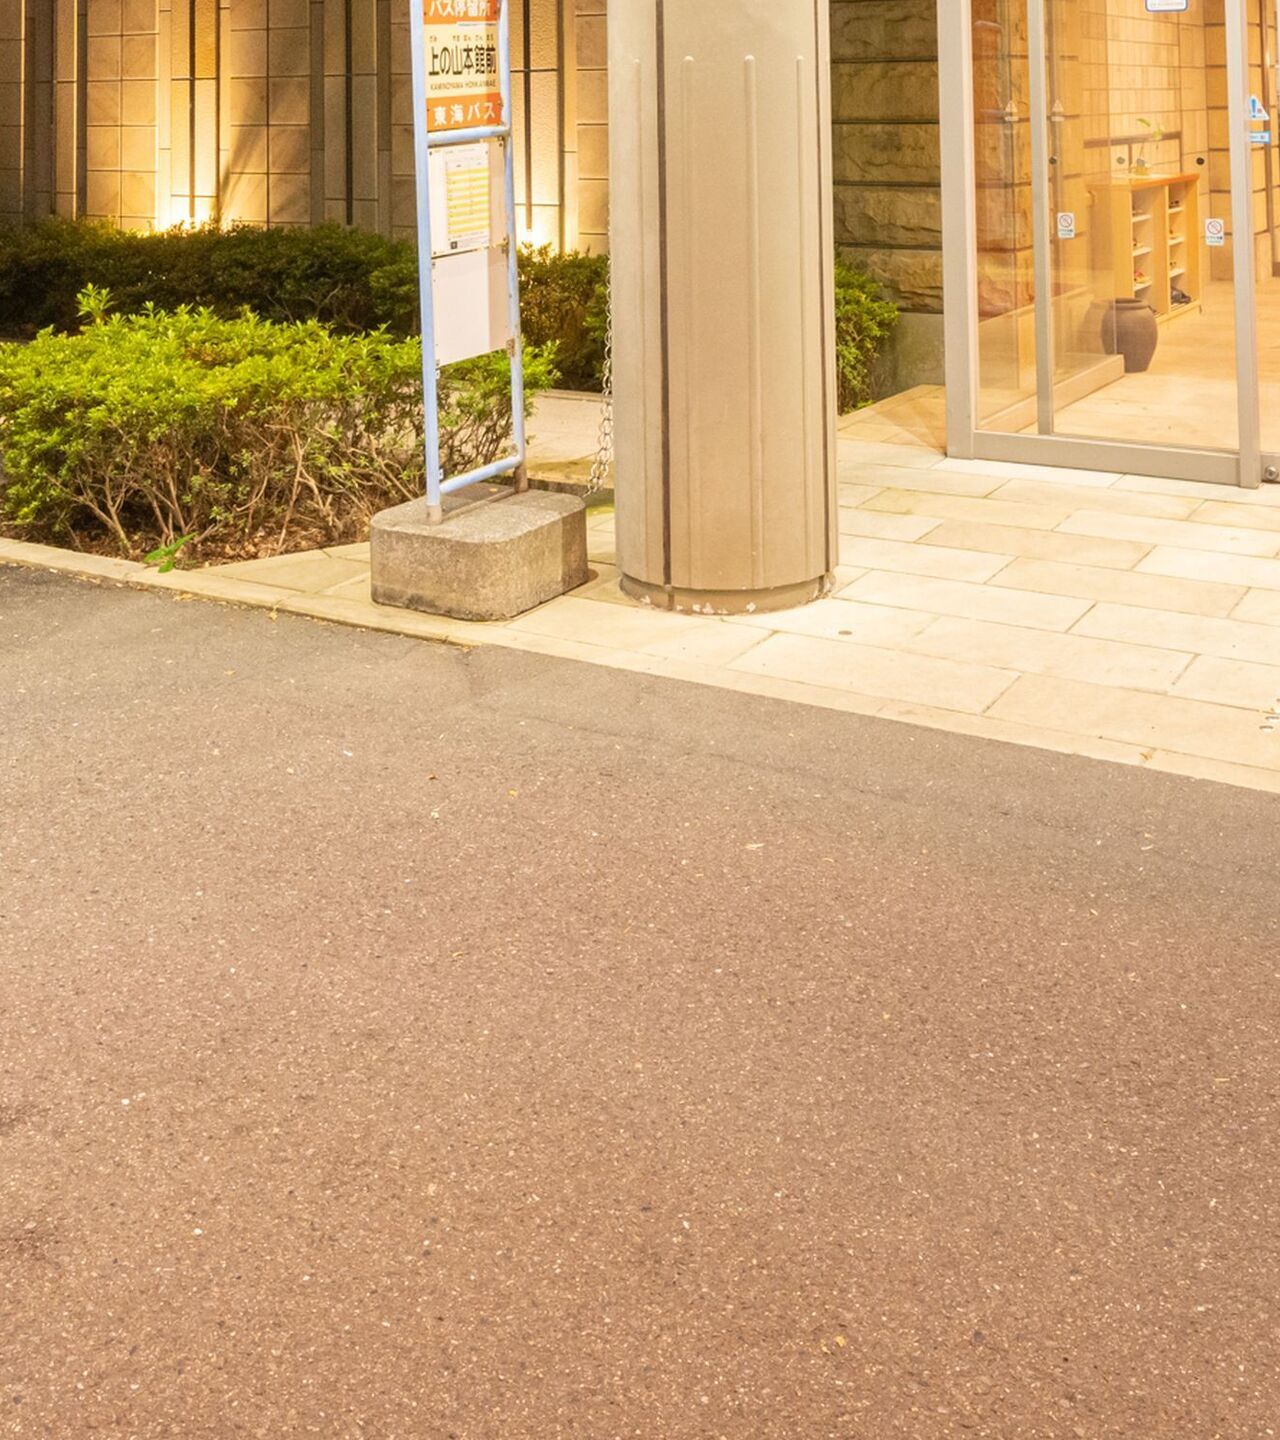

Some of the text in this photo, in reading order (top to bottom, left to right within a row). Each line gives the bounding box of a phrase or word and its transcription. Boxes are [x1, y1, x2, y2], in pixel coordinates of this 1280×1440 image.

[428, 44, 496, 76] 上の山本館前
[434, 102, 495, 126] 東海バス
